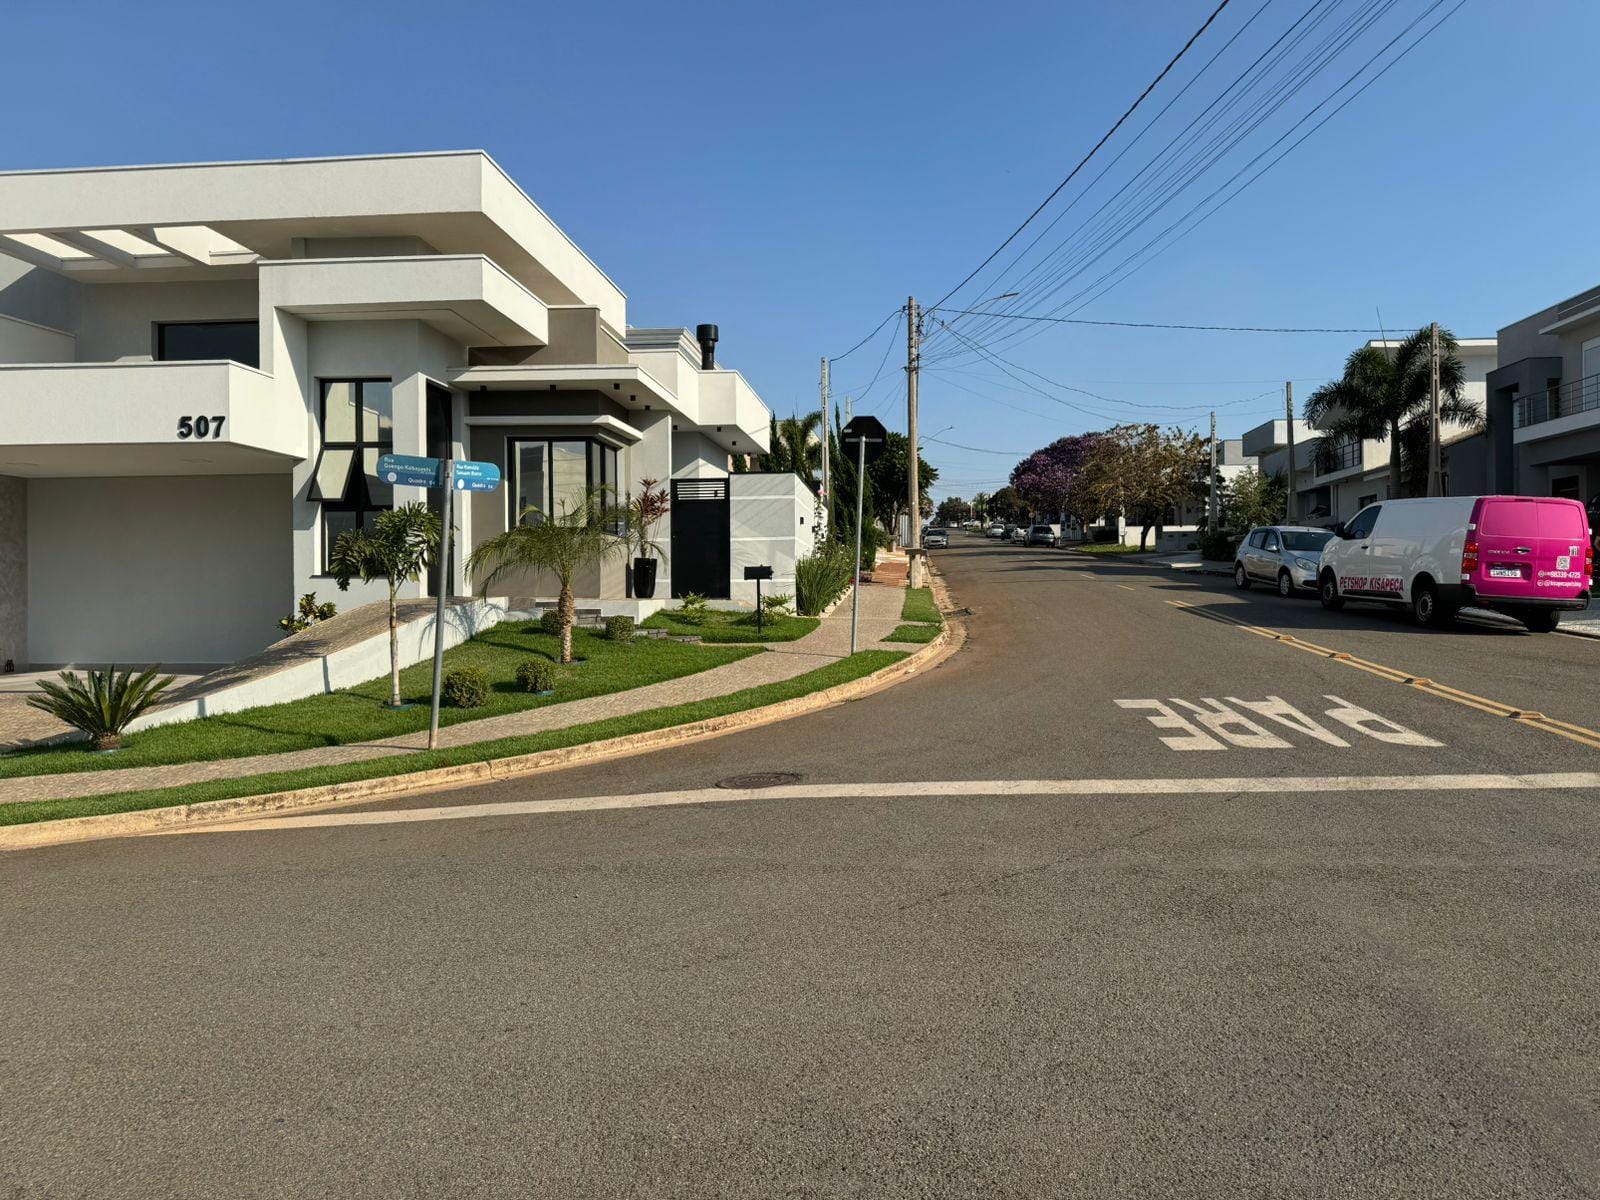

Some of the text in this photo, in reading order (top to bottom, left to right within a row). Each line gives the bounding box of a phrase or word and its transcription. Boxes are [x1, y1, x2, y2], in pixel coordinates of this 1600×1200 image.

[177, 415, 226, 439] 507
[1340, 576, 1368, 590] PETSHOP
[1112, 694, 1447, 751] PARE
